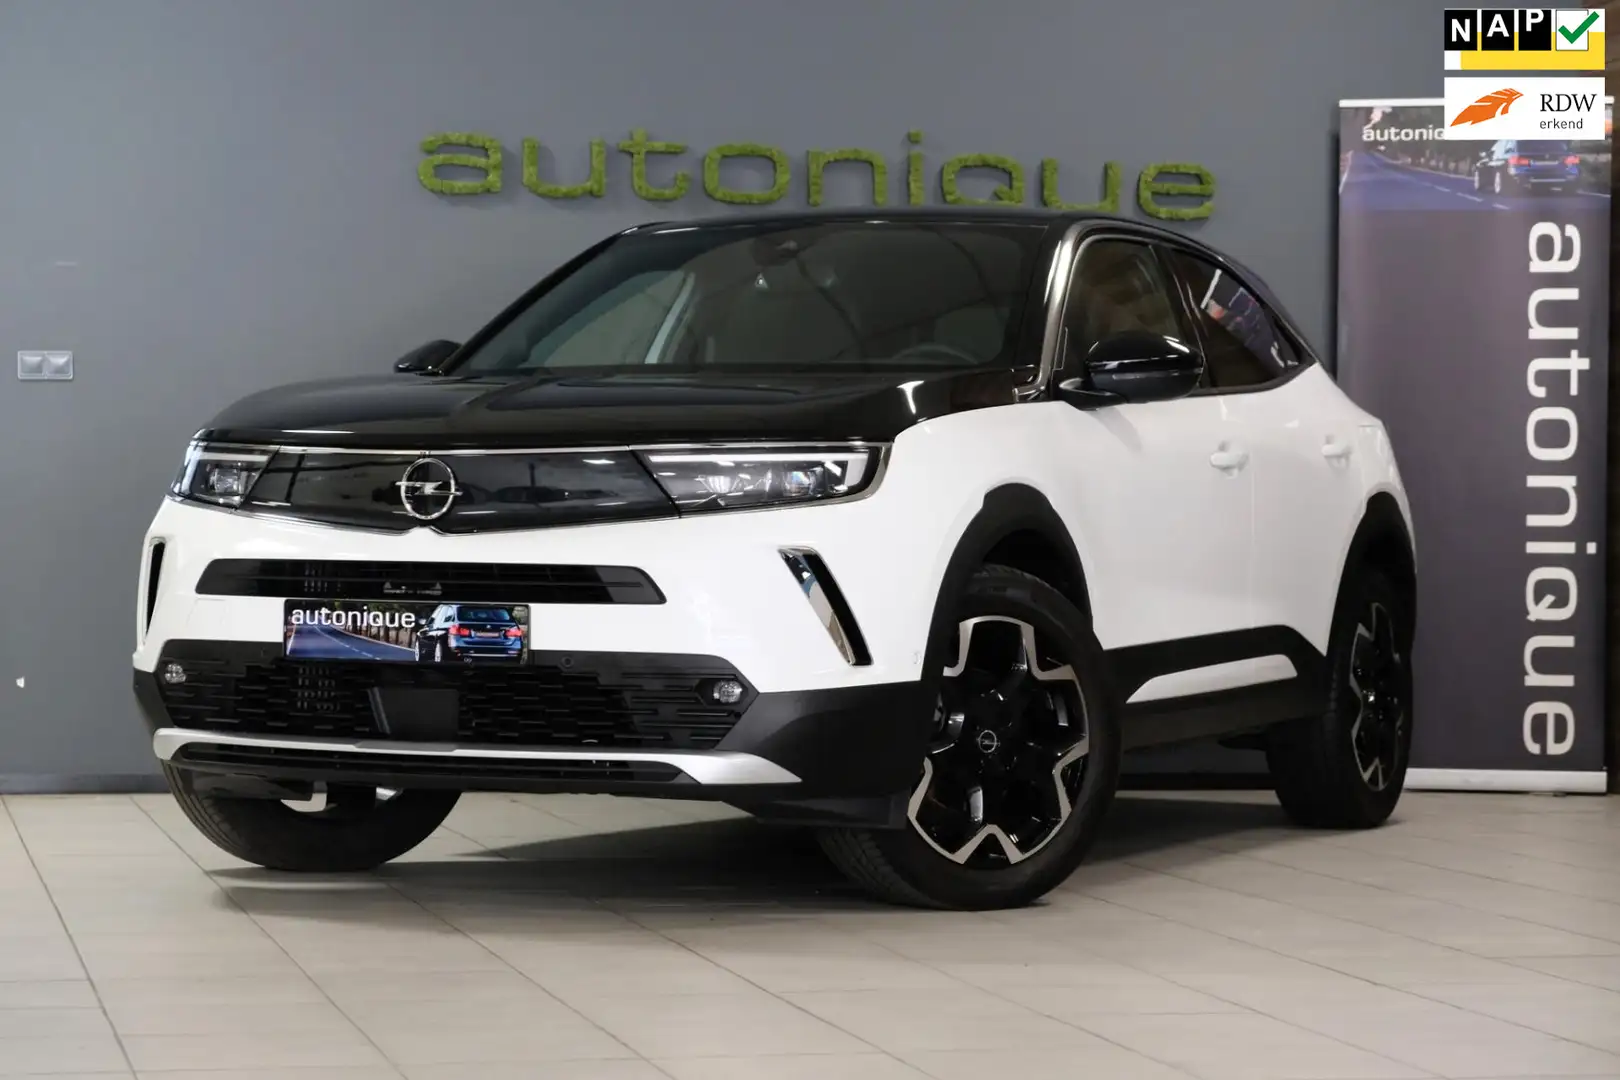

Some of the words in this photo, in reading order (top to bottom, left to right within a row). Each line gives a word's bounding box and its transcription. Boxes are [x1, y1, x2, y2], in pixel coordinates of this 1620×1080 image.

[417, 129, 1217, 221] autonique
[1522, 221, 1598, 756] autonique
[290, 605, 417, 628] autonique
